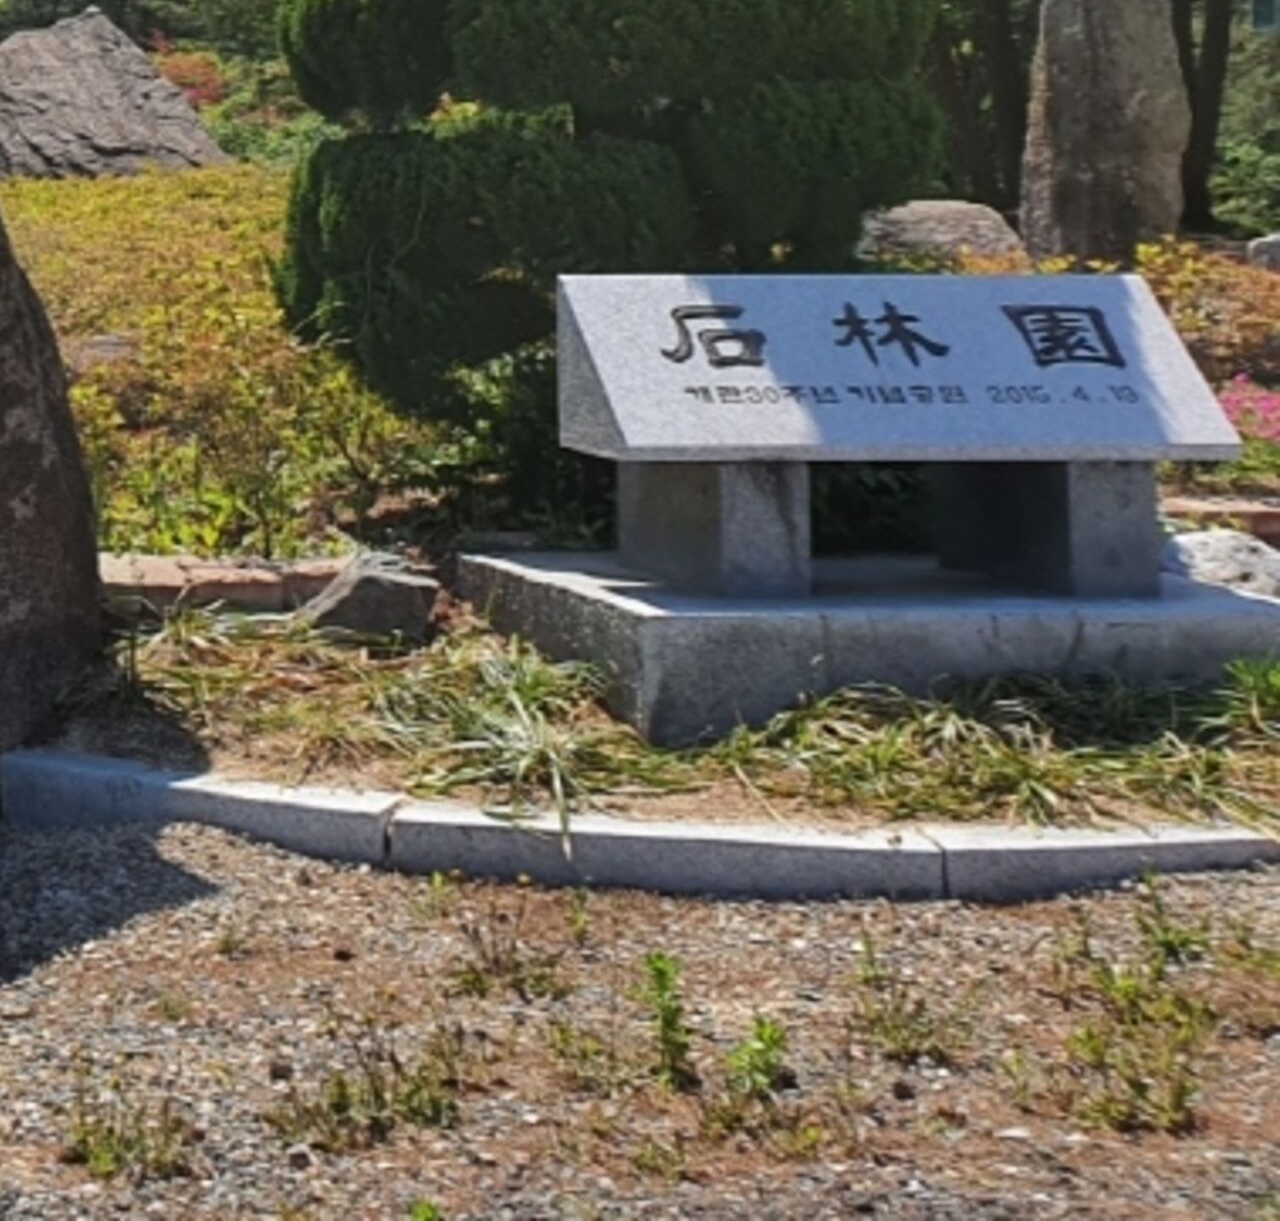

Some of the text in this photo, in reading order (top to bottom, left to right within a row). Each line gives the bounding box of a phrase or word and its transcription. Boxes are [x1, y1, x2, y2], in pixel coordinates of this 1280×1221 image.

[660, 301, 1127, 368] 石林園
[685, 385, 840, 404] 개관30주년
[846, 385, 968, 404] 기념공원
